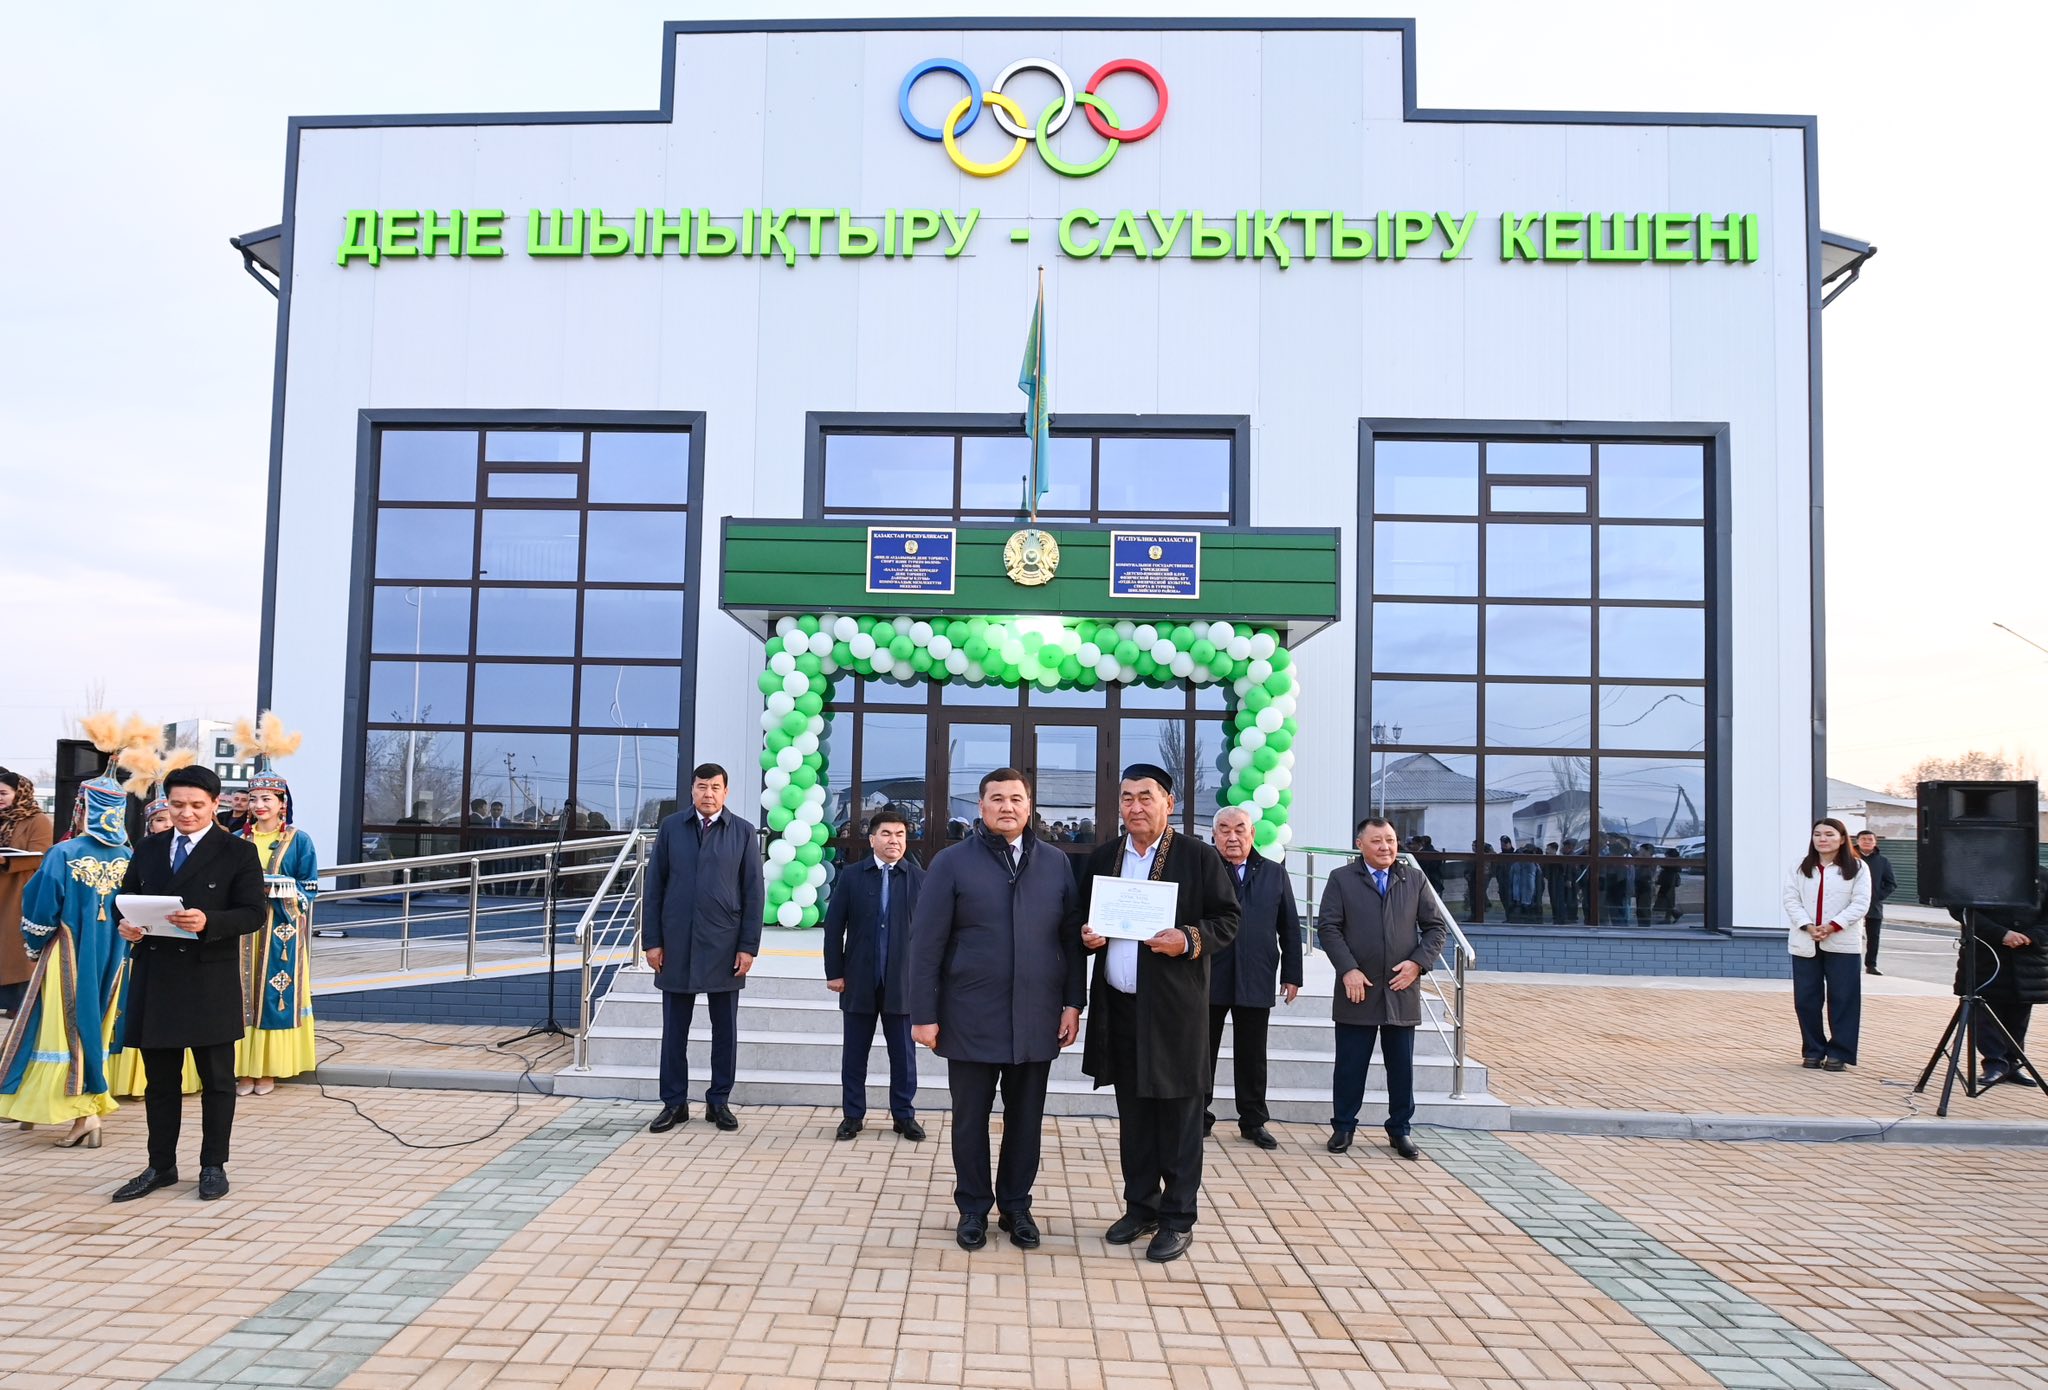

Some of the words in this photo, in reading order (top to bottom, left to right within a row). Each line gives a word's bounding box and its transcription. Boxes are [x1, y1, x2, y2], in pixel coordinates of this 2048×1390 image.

[337, 209, 504, 266] ДЕНЕ
[526, 207, 981, 268] ШЫНЫҚТЫРУ
[1058, 208, 1478, 270] САУЫҚТЫРУ
[1499, 211, 1759, 265] КЕШЕНІ
